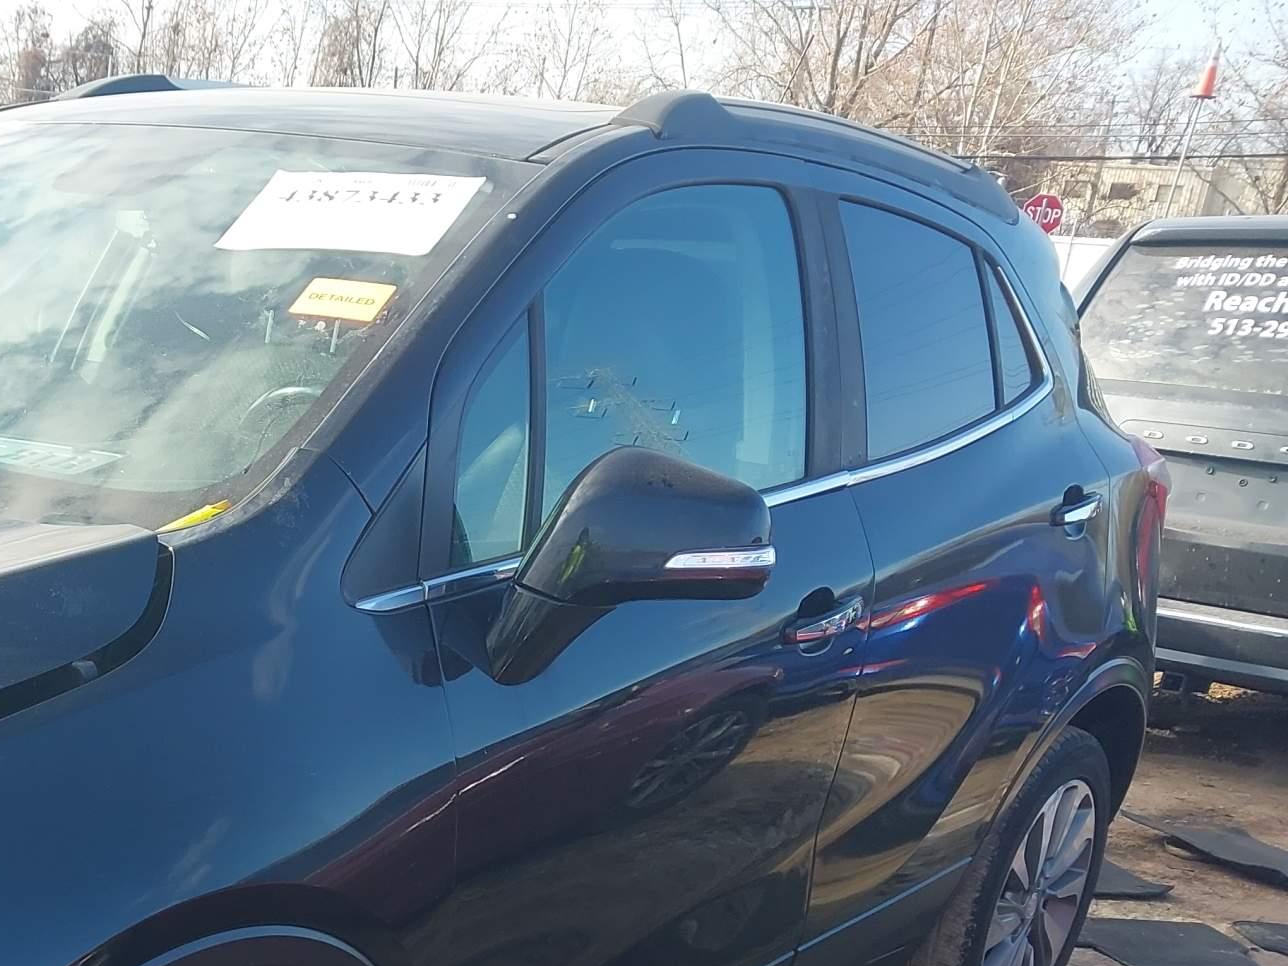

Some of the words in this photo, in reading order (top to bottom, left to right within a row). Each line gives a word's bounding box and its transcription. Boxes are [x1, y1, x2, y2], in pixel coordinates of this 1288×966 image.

[1026, 206, 1062, 224] STOP
[1175, 255, 1254, 271] Bridging
[1255, 254, 1288, 268] the
[1176, 273, 1216, 287] with
[1217, 273, 1277, 287] ID/DD
[308, 292, 375, 306] DETAILED
[1202, 290, 1288, 313] Reach
